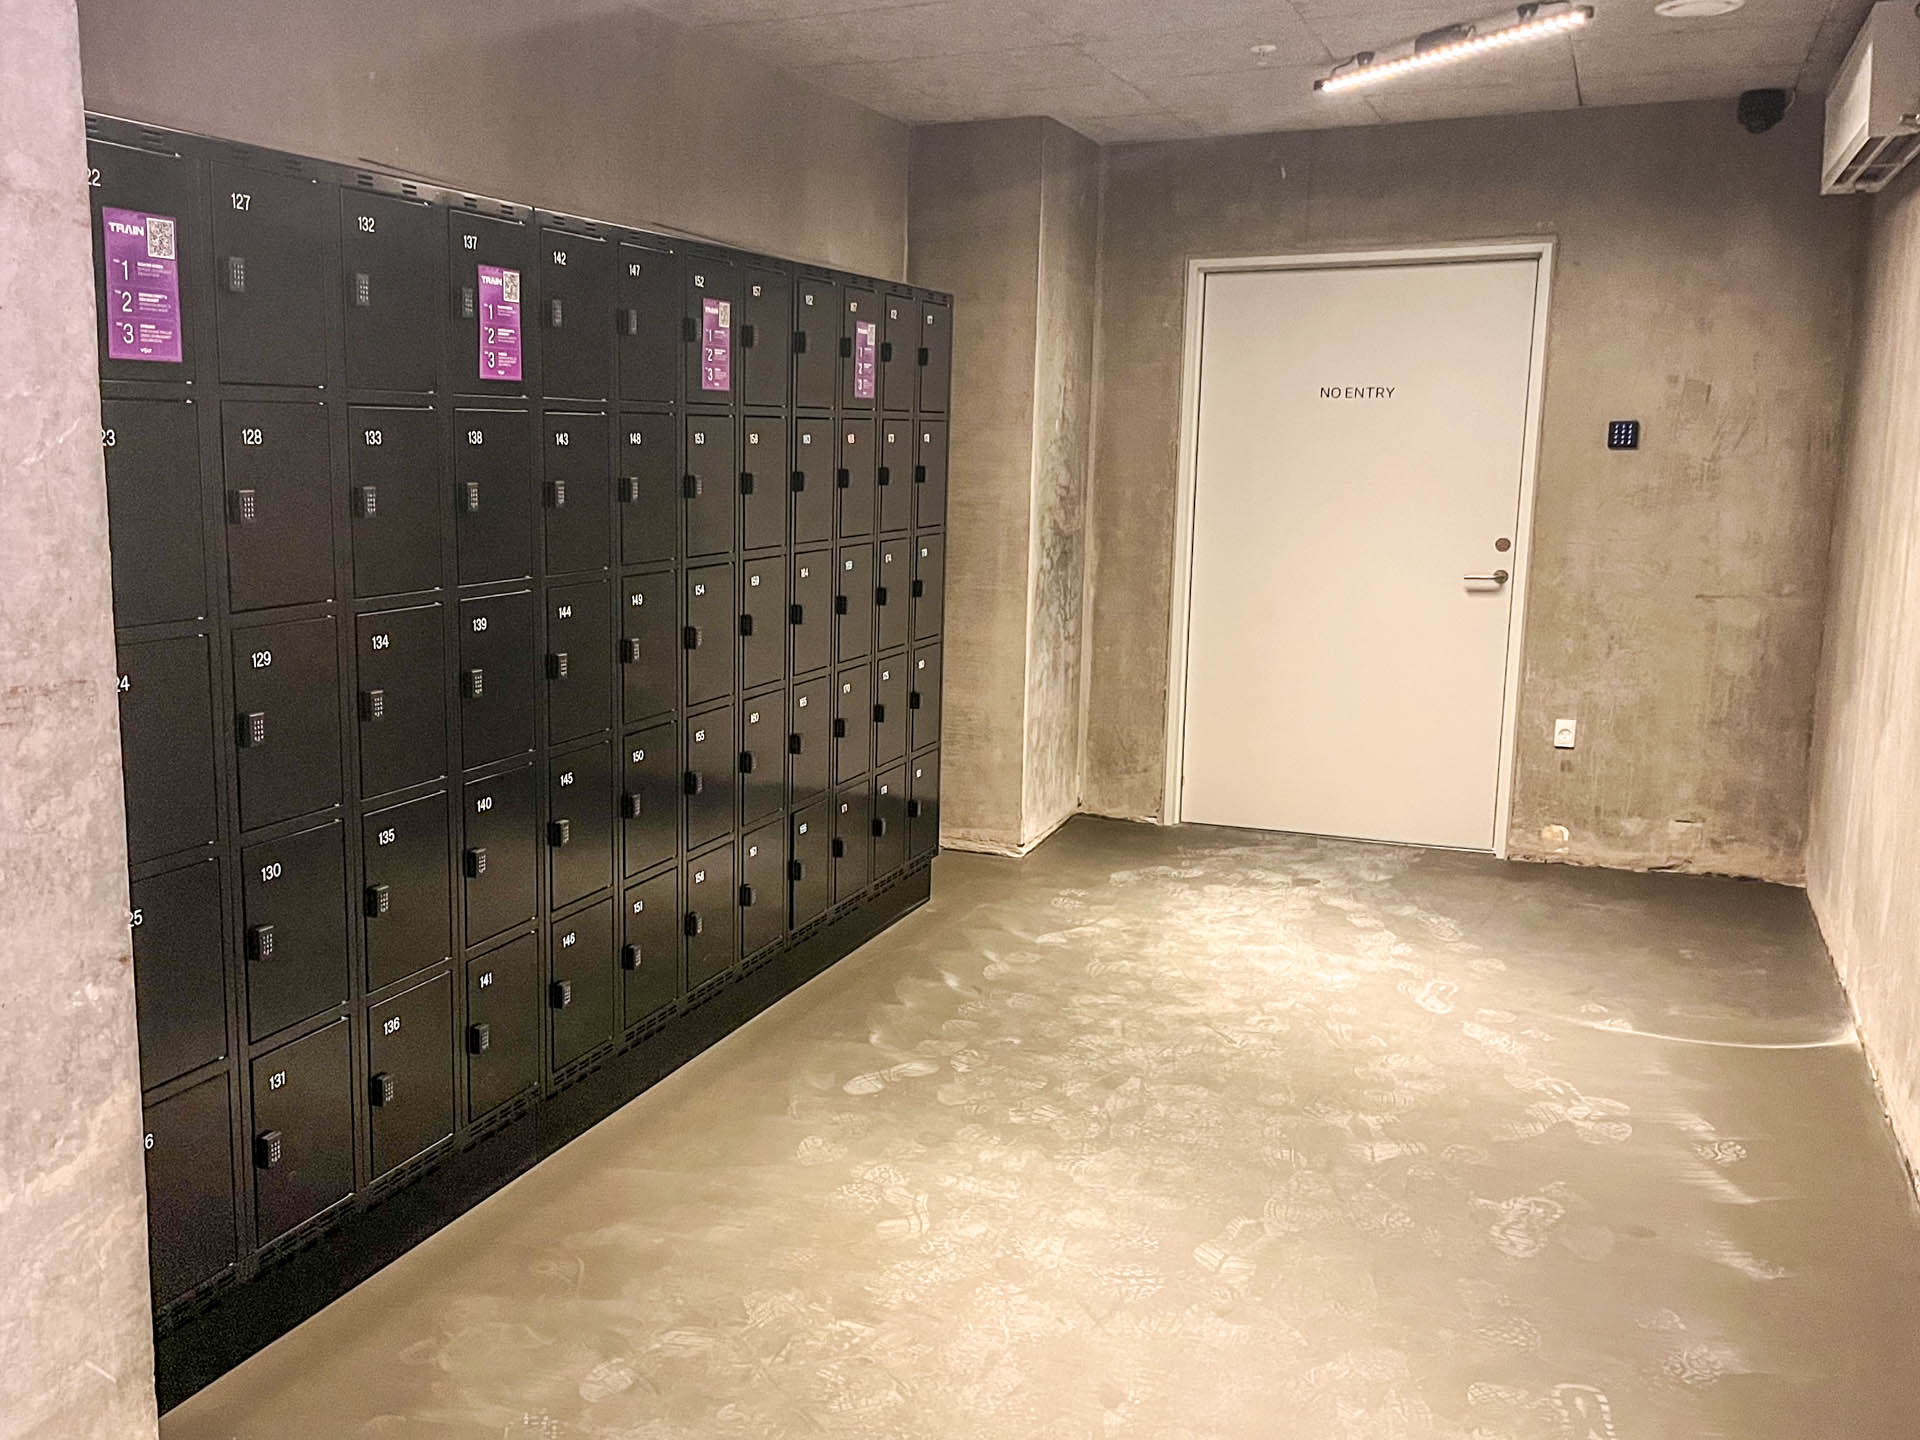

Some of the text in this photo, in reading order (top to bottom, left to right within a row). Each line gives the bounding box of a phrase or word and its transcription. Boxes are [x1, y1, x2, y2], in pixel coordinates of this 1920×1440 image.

[231, 192, 251, 211] 127
[108, 222, 144, 236] TRAIN
[357, 216, 375, 233] 132
[463, 234, 478, 250] 137
[553, 251, 567, 266] 142
[122, 259, 128, 280] 1
[122, 291, 133, 312] 2
[488, 304, 493, 320] 1
[123, 323, 134, 344] 3
[488, 328, 495, 344] 2
[488, 352, 495, 368] 3
[1320, 387, 1395, 399] NO ENTRY
[241, 428, 263, 445] 128
[364, 430, 382, 445] 133
[467, 430, 483, 445] 138
[555, 432, 569, 446] 143
[558, 605, 572, 619] 144
[472, 617, 487, 632] 139
[371, 634, 390, 650] 134
[251, 650, 272, 668] 129
[560, 771, 574, 787] 145
[477, 796, 492, 813] 140
[378, 828, 395, 846] 135
[261, 862, 282, 882] 130
[562, 932, 576, 948] 146
[479, 972, 492, 988] 141
[383, 1016, 400, 1035] 136
[269, 1070, 286, 1090] 131
